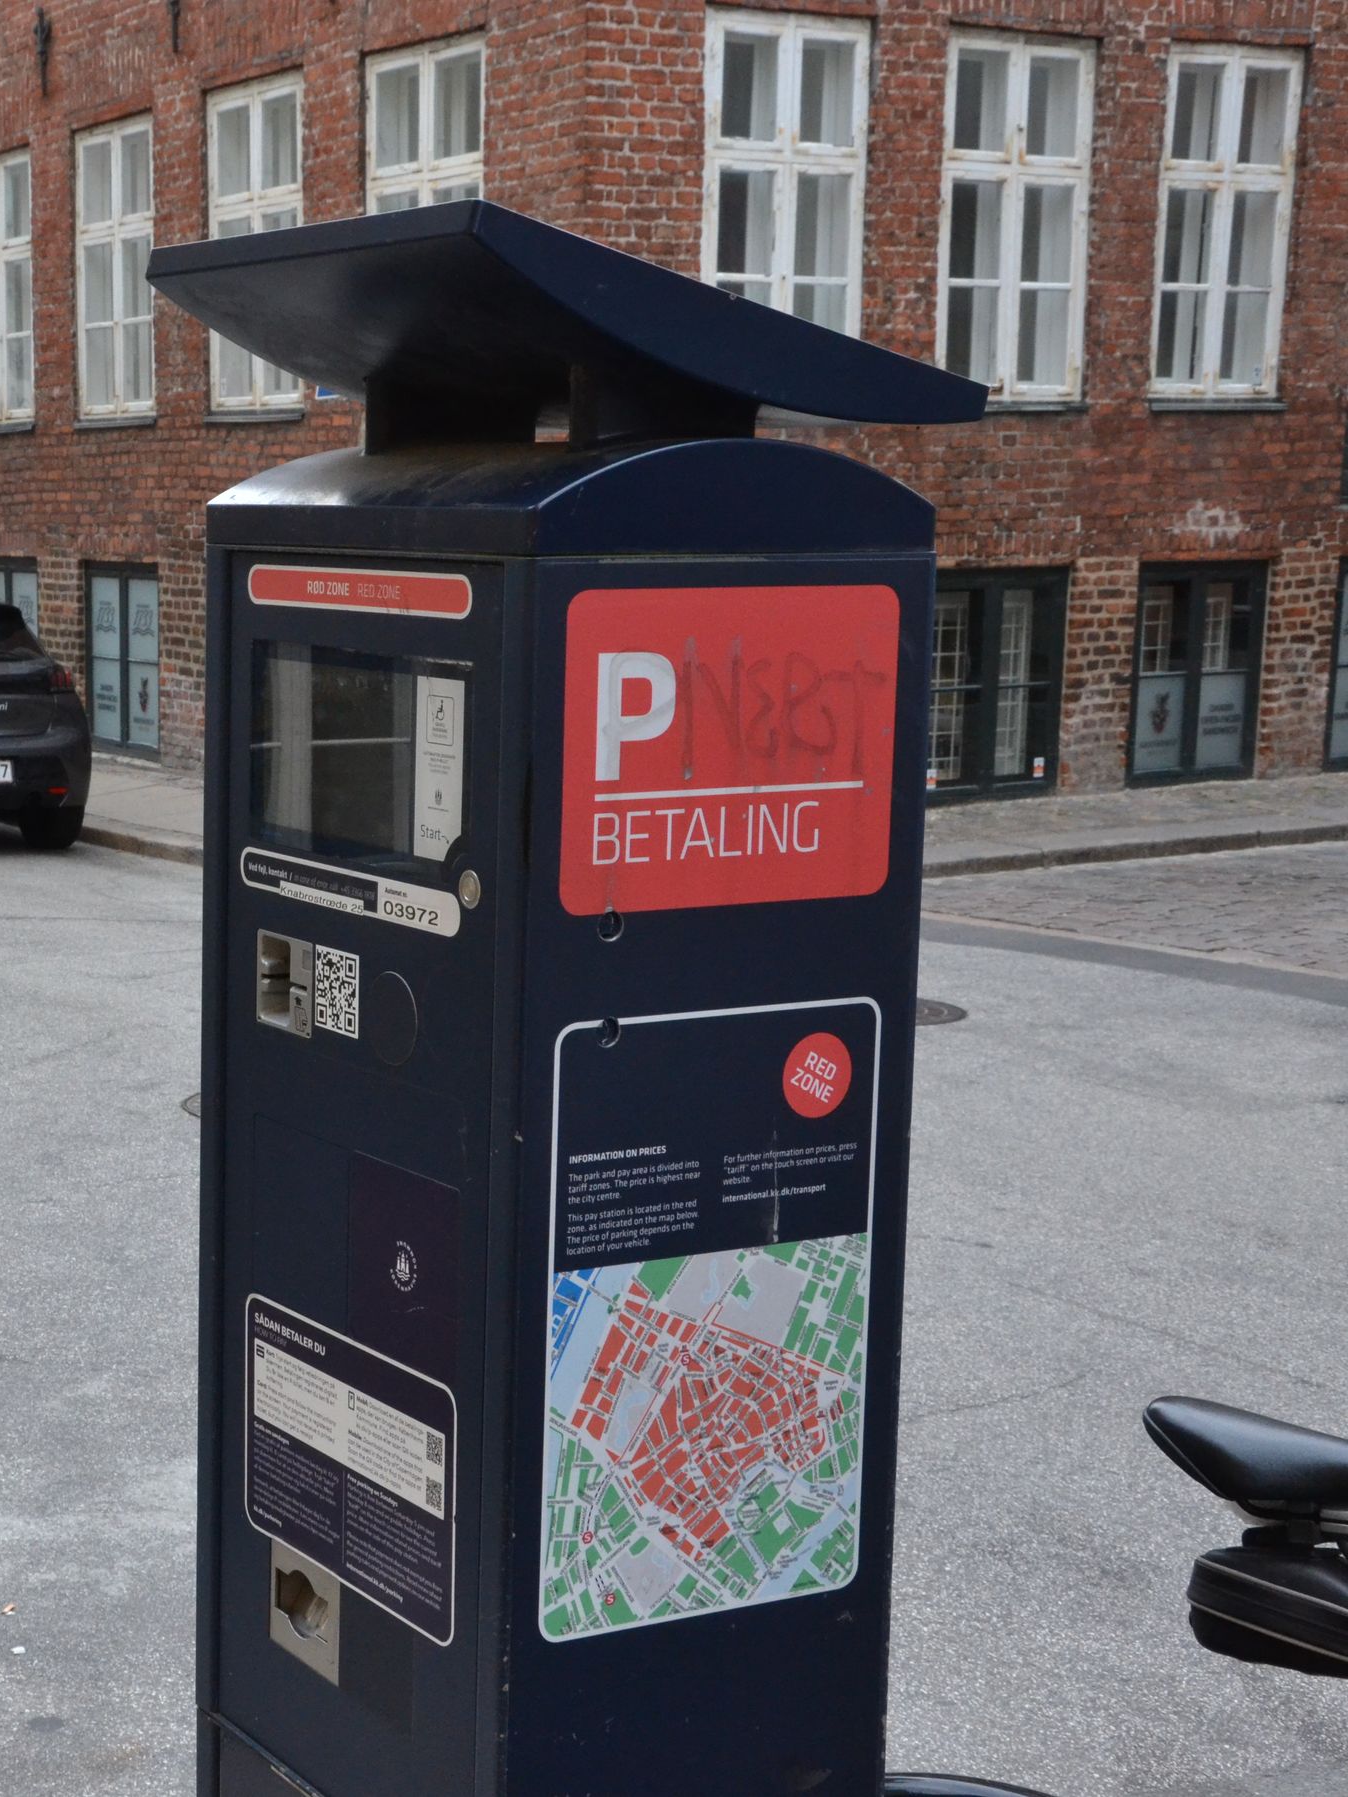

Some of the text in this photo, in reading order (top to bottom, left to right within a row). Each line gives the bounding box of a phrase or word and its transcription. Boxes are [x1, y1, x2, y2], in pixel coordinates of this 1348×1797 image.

[307, 580, 350, 596] RØD ZONE
[357, 583, 401, 600] RED ZONE
[595, 651, 677, 782] P
[420, 824, 442, 841] Start
[592, 800, 820, 865] BETALING
[280, 885, 348, 911] Knabrostræde
[350, 903, 364, 914] 25
[383, 900, 439, 927] 03972
[804, 1050, 837, 1081] RED
[790, 1067, 834, 1103] ZONE
[569, 1145, 667, 1164] INFORMATION ON PRICES
[724, 1155, 736, 1164] For
[737, 1152, 763, 1162] further
[763, 1148, 804, 1159] information
[805, 1146, 814, 1154] on
[839, 1142, 858, 1151] press
[751, 1164, 760, 1172] on
[762, 1162, 773, 1170] the
[774, 1160, 794, 1169] touch
[796, 1158, 818, 1166] screen
[827, 1154, 842, 1162] visit
[584, 1171, 600, 1182] park
[602, 1170, 615, 1178] and
[617, 1169, 631, 1177] pay
[632, 1165, 648, 1175] area
[650, 1165, 656, 1173] is
[657, 1161, 683, 1172] divided
[685, 1161, 699, 1169] into
[568, 1183, 587, 1193] tariff
[589, 1182, 612, 1191] zones.
[630, 1176, 647, 1188] price
[648, 1175, 654, 1184] is
[656, 1173, 683, 1185] highest
[722, 1184, 826, 1203] international.kk.dk/transport
[568, 1192, 622, 1205] the city centre.
[568, 1199, 697, 1222] This pay station is located in the red
[599, 1218, 632, 1229] indicated
[634, 1218, 643, 1226] on
[645, 1215, 657, 1223] the
[659, 1213, 675, 1222] map
[567, 1236, 580, 1244] The
[582, 1233, 600, 1244] price
[601, 1231, 610, 1239] of
[611, 1227, 638, 1240] parking
[639, 1223, 670, 1235] depends
[672, 1223, 681, 1231] on
[566, 1238, 652, 1255] location of your vehicle.
[254, 1310, 325, 1357] SÅDAN BETALER DU
